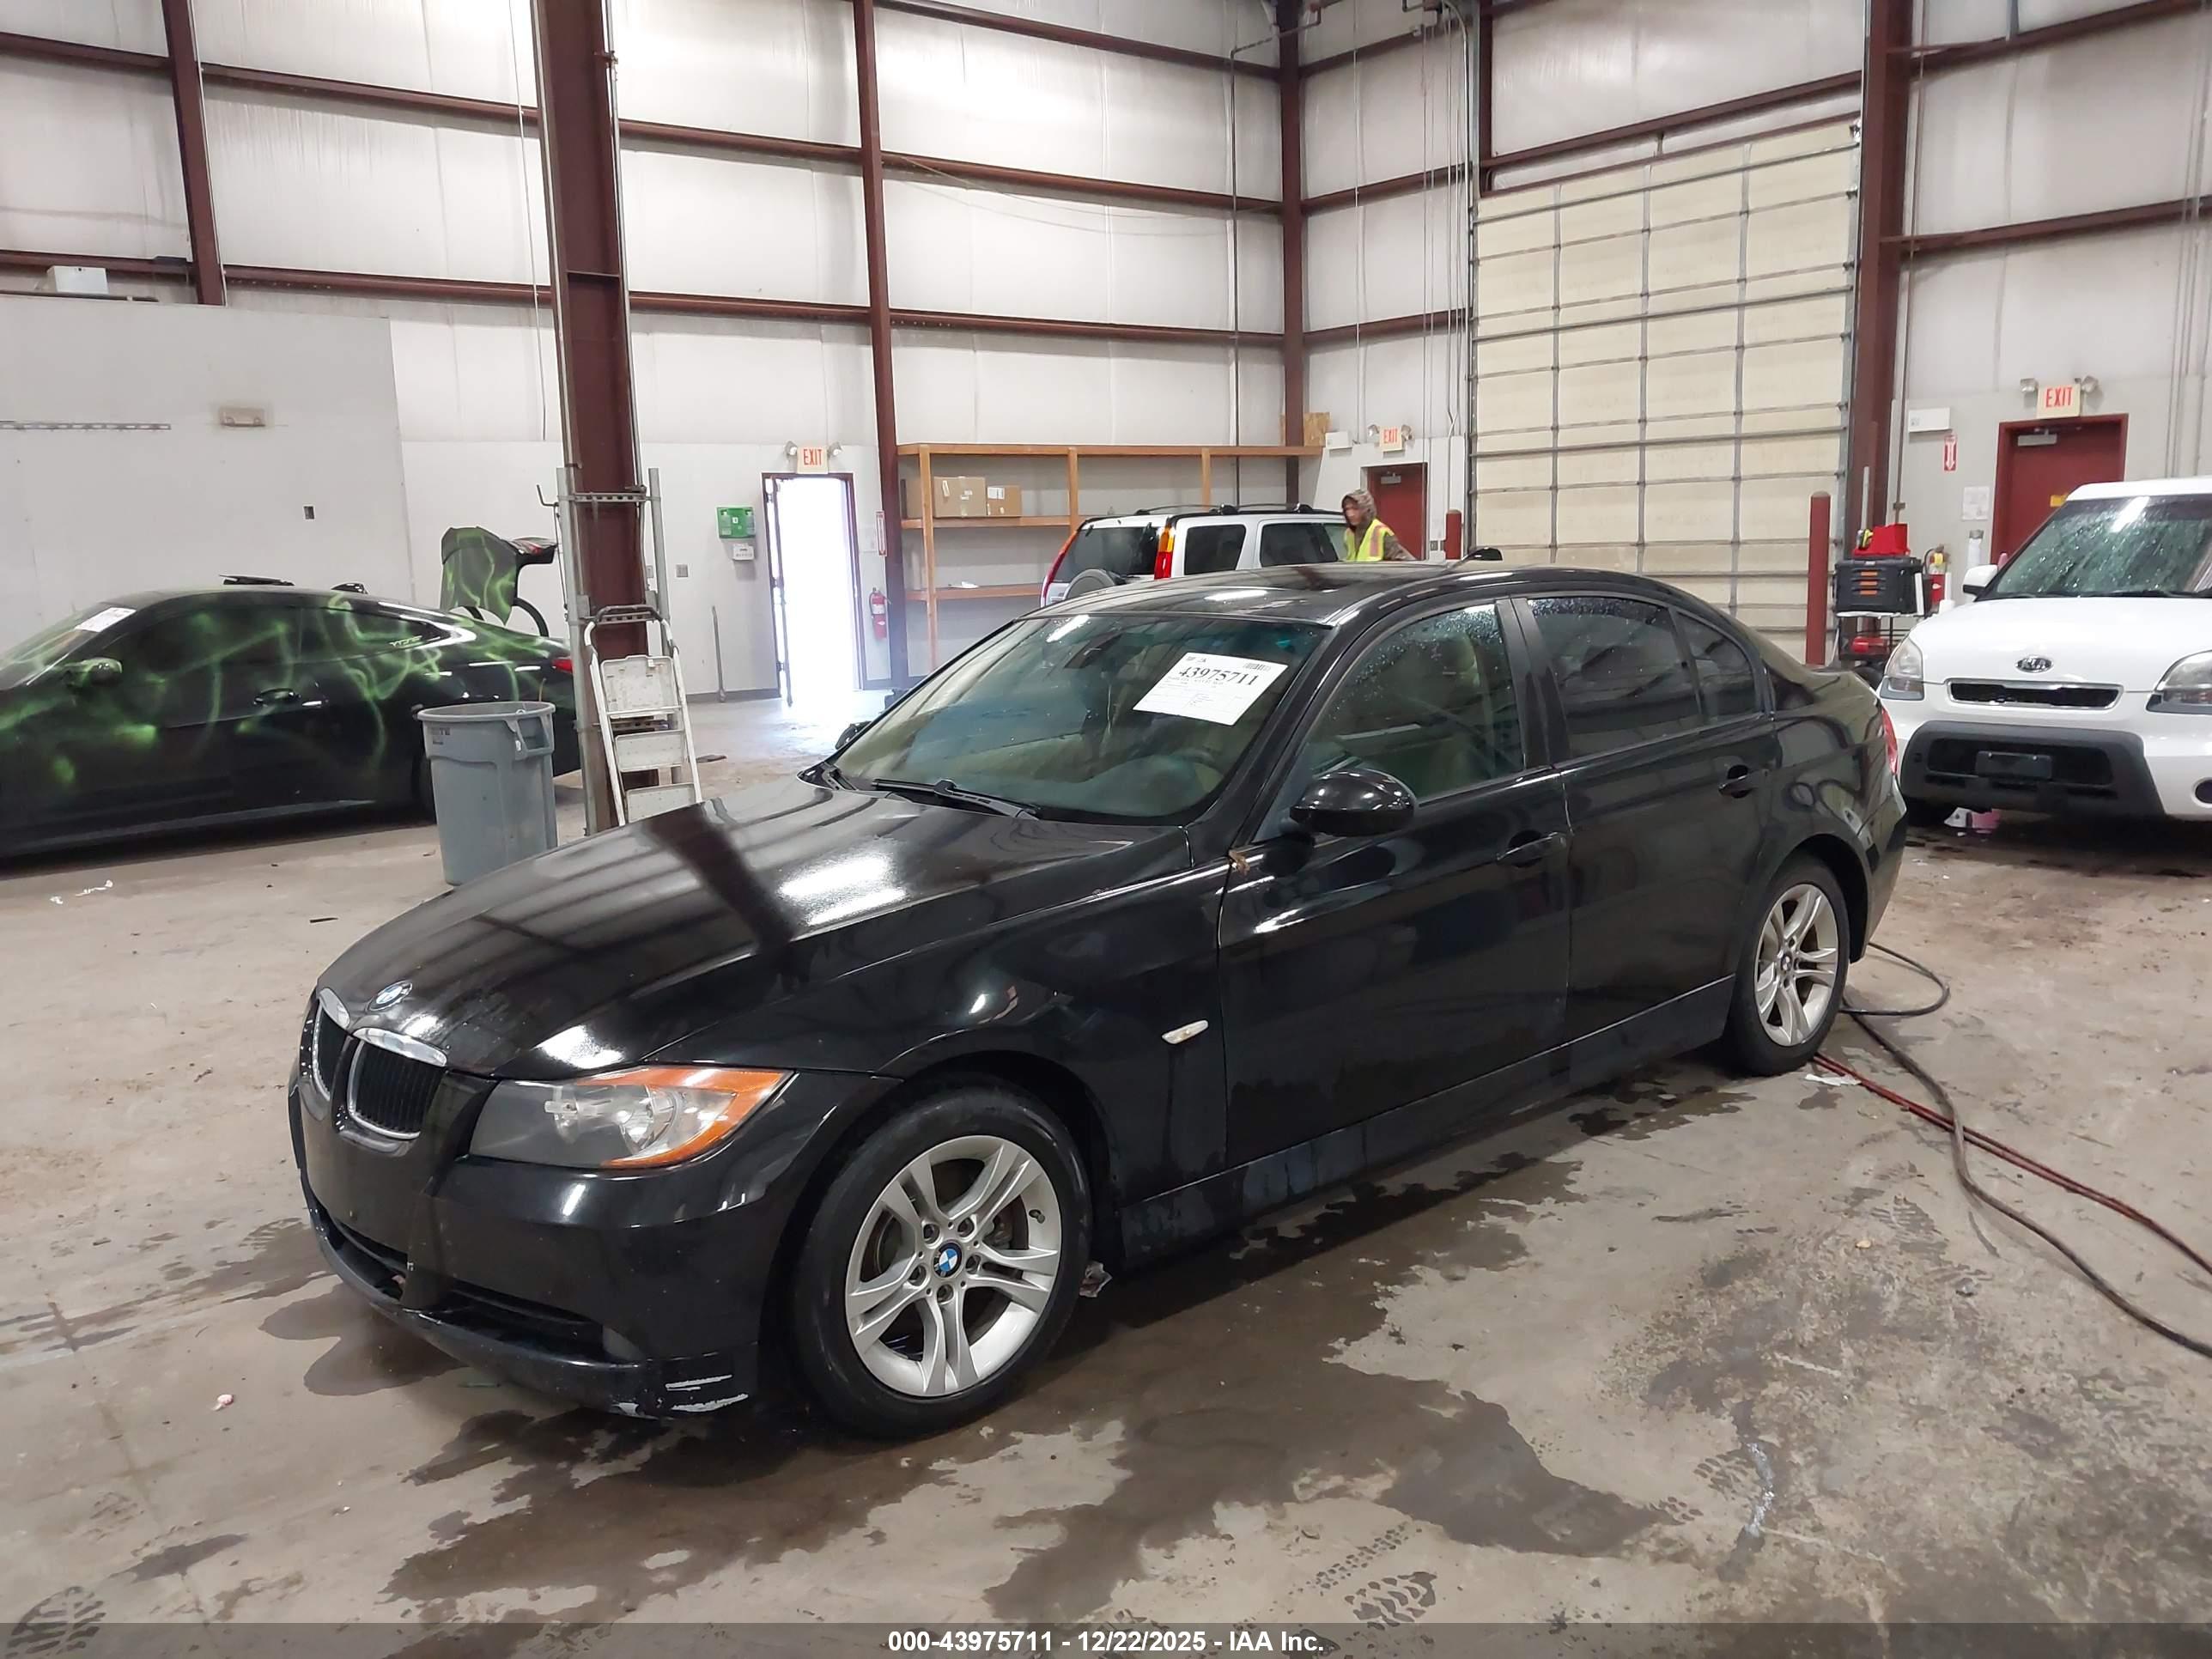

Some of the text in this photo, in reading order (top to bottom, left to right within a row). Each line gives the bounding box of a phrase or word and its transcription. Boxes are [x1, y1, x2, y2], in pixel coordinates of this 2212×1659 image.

[2045, 386, 2073, 408] EXIT
[1383, 428, 1398, 443] EXIT
[803, 448, 823, 465] EXIT
[1179, 666, 1259, 686] 43975711
